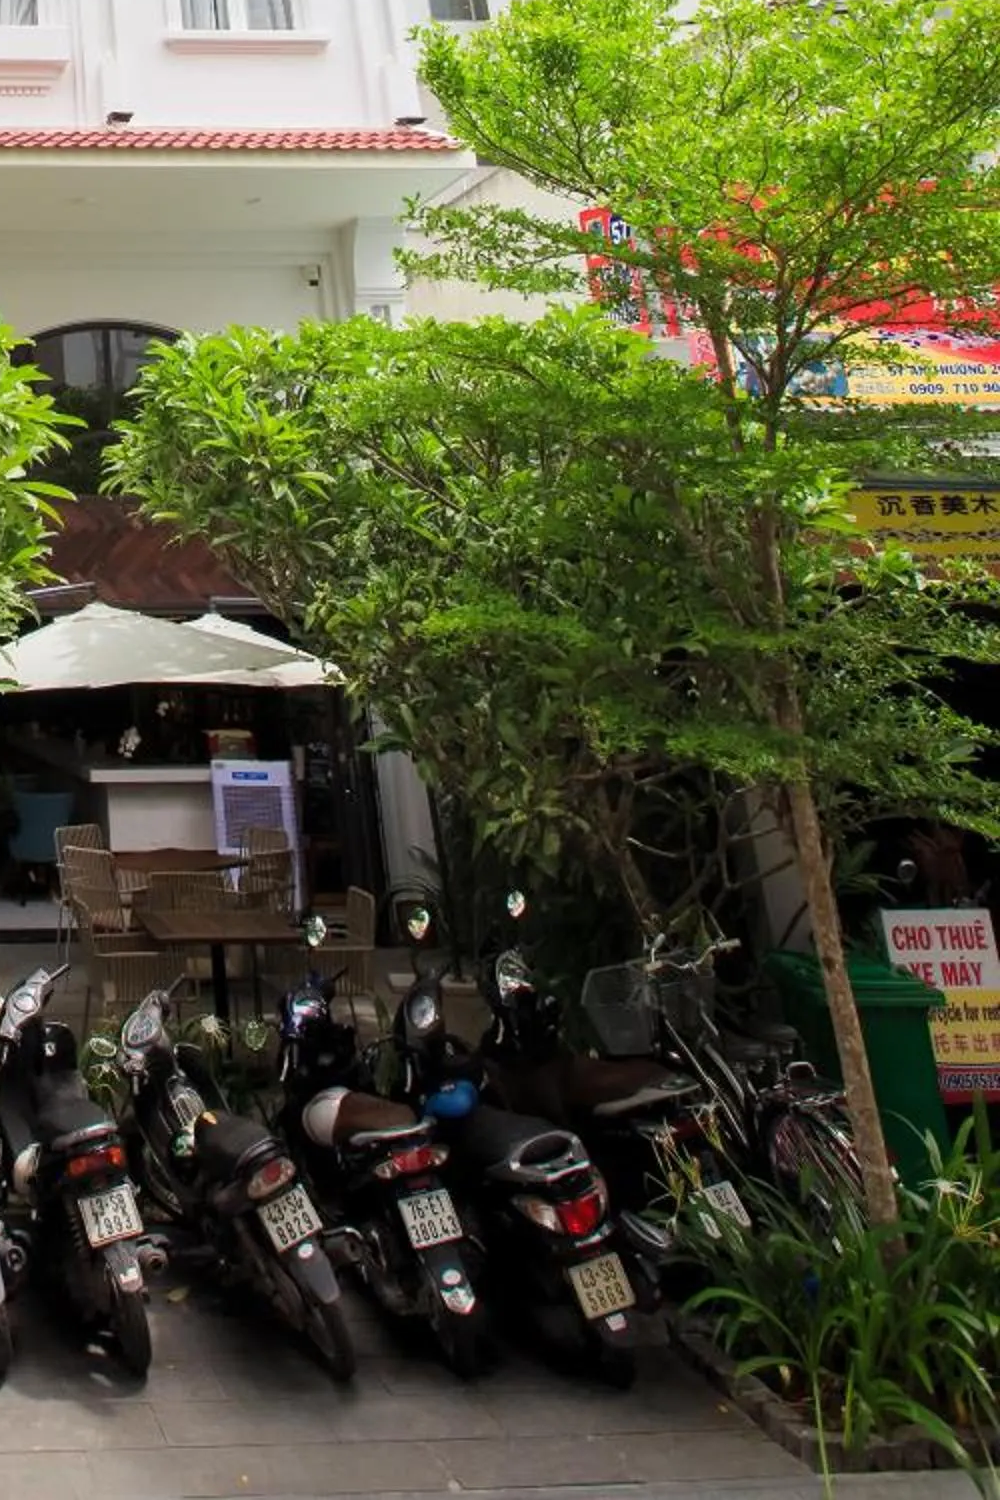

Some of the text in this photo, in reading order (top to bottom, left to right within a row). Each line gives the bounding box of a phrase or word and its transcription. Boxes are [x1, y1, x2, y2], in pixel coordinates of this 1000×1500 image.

[891, 919, 988, 950] CHO THUÊ
[940, 955, 982, 987] MÁY
